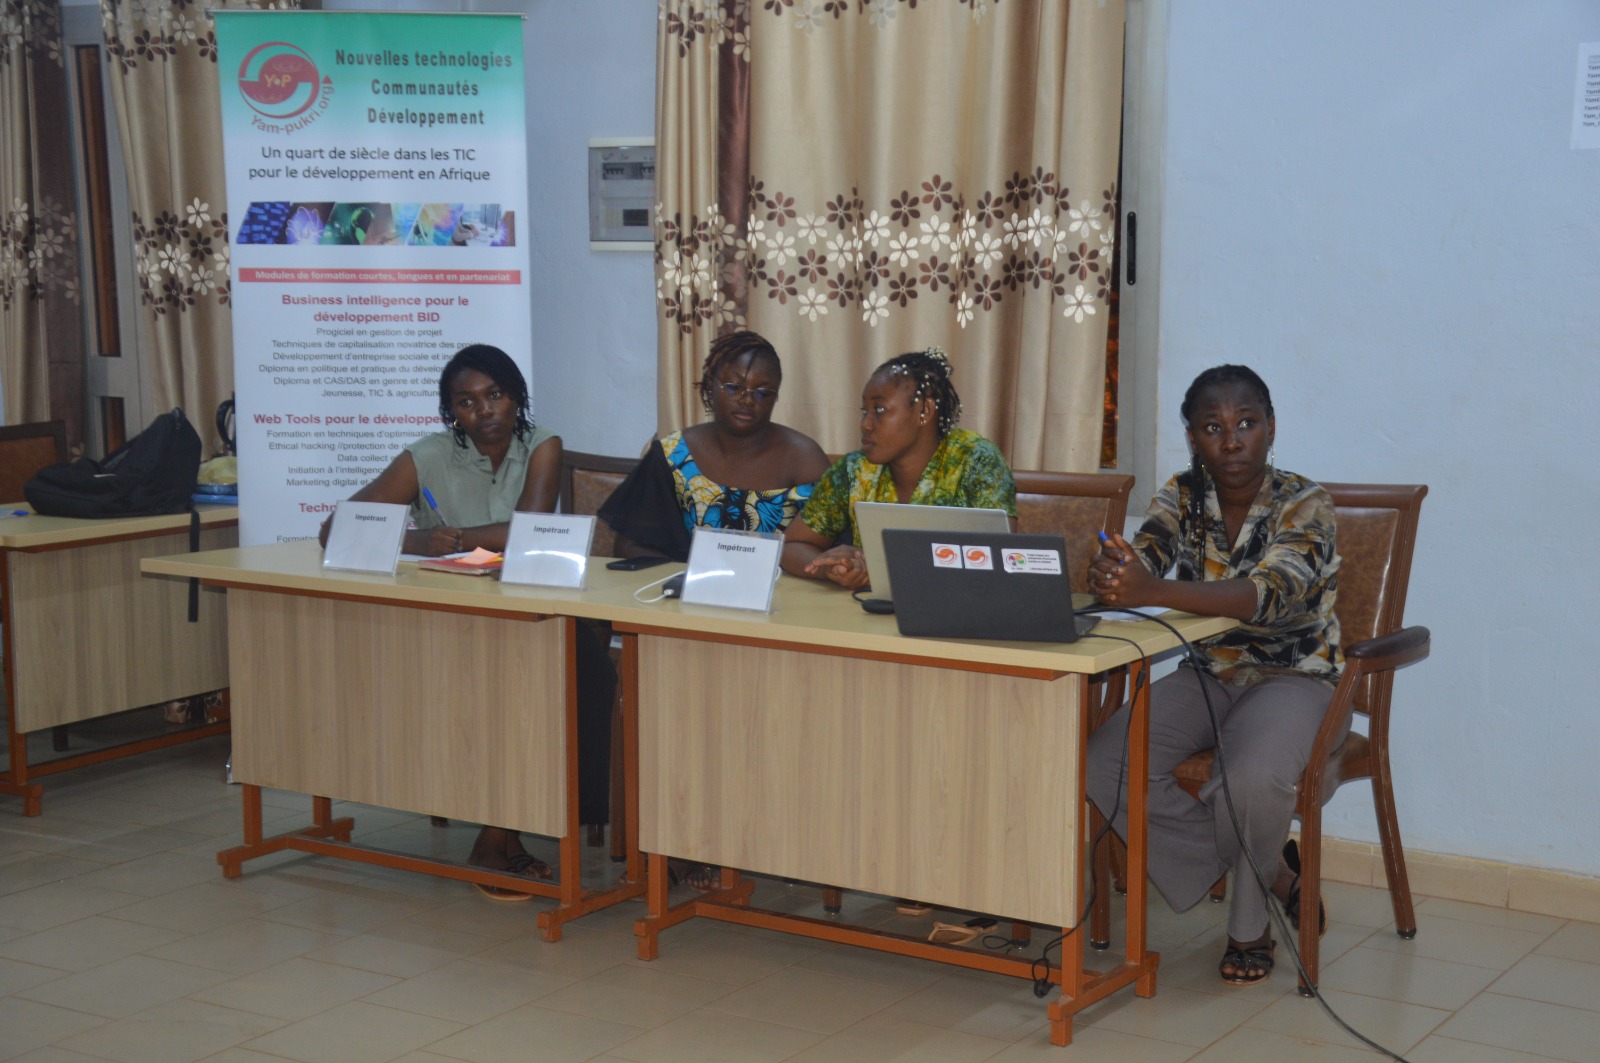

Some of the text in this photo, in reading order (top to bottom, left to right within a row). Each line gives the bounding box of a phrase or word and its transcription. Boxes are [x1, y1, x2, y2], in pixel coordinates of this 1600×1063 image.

[336, 49, 512, 70] Nouvelles technologies
[371, 79, 478, 96] Communautés
[251, 85, 335, 135] Yam-pukri.org
[368, 108, 484, 128] Développement
[262, 147, 476, 163] Un quart de siècle dans les TIC
[249, 166, 490, 182] pour le développement en Afrique
[256, 271, 295, 279] Modules
[311, 272, 356, 280] formation
[359, 272, 395, 281] courtes,
[398, 273, 432, 282] longues
[460, 273, 510, 282] partenariat
[282, 294, 468, 308] Business intelligence pour le
[314, 312, 440, 324] développement BID
[316, 328, 354, 337] Progiciel
[370, 328, 400, 337] gestion
[418, 329, 442, 338] projet
[272, 340, 322, 348] Techniques
[338, 340, 394, 349] capitalisation
[273, 352, 342, 362] Développement
[344, 352, 395, 362] d'entreprise
[259, 364, 295, 374] Diploma
[311, 364, 348, 374] politique
[361, 365, 396, 374] pratique
[274, 377, 310, 386] Diploma
[382, 378, 407, 386] genre
[322, 389, 366, 398] Jeunesse,
[254, 414, 282, 424] Web
[285, 414, 321, 424] Tools
[325, 415, 354, 426] pour
[358, 414, 369, 424] le
[328, 430, 374, 438] techniques
[376, 430, 432, 438] d'optimisatio
[301, 442, 335, 451] hacking
[288, 466, 325, 474] Initiation
[286, 478, 330, 487] Marketing
[332, 478, 358, 487] digital
[355, 513, 386, 523] Impétrant
[534, 524, 570, 535] Impétrant
[717, 542, 756, 554] Impétrant
